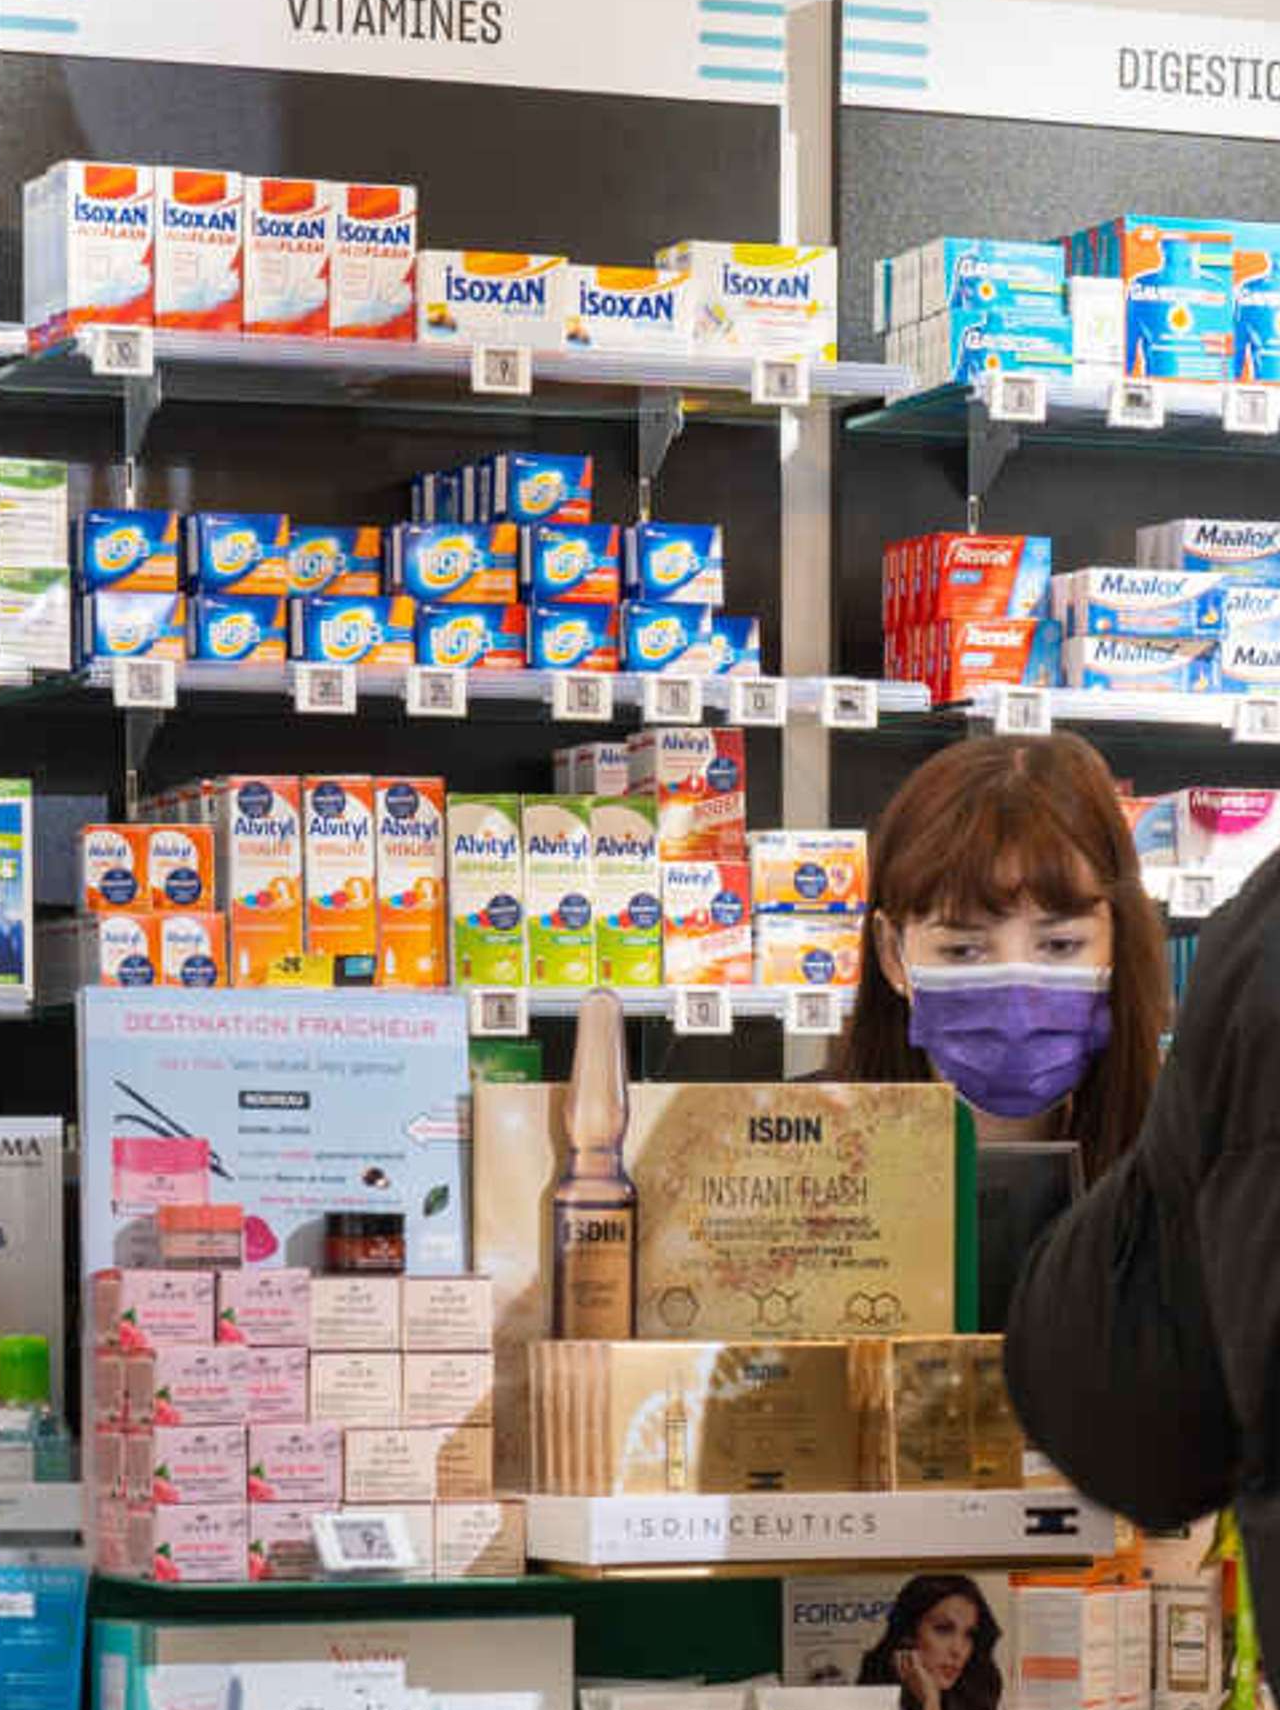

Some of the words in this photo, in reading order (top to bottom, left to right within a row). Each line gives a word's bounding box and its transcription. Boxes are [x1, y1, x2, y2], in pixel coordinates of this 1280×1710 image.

[1196, 523, 1280, 549] Maalox
[234, 816, 296, 842] Alvityl
[308, 816, 370, 843] Alvityl
[381, 817, 441, 843] Alvityl
[454, 833, 517, 861] Alvityl
[528, 833, 589, 861] Alvityl
[595, 834, 656, 862] Alvityl
[123, 1011, 288, 1038] DESTINATION
[749, 1116, 822, 1142] ISDIN
[563, 1217, 626, 1243] ISDIN
[623, 1511, 879, 1539] ISDINCEUTICS
